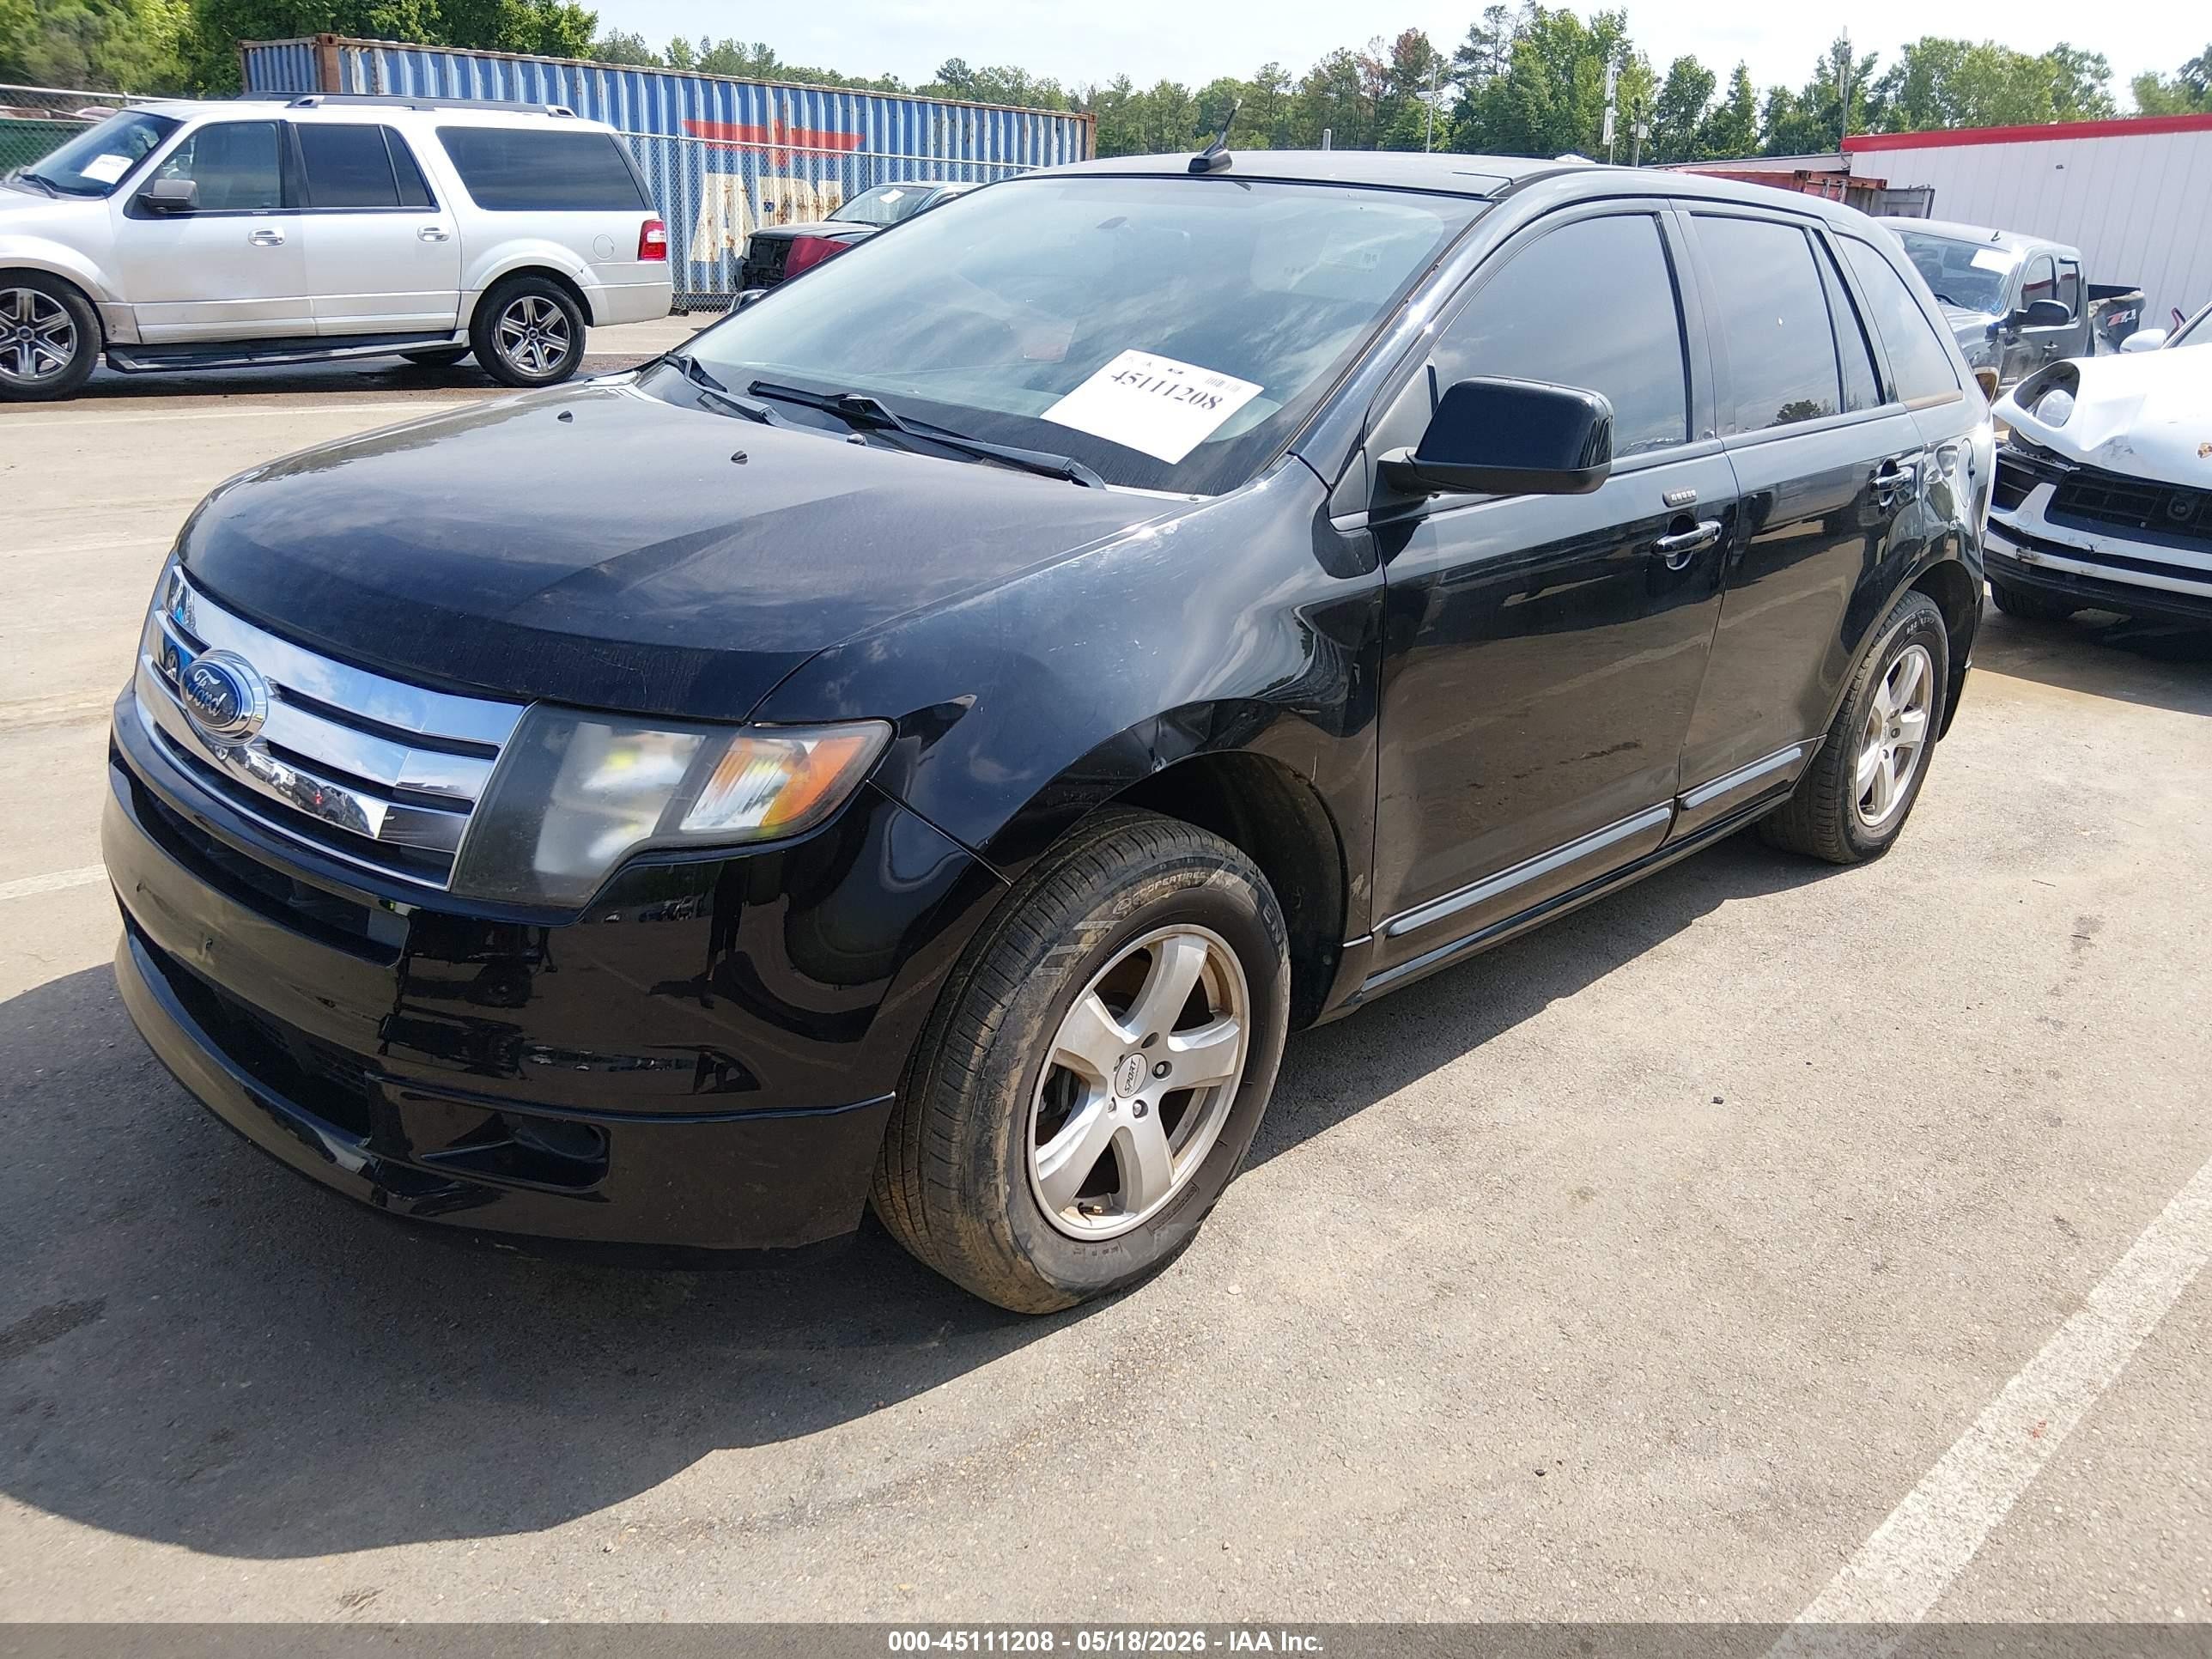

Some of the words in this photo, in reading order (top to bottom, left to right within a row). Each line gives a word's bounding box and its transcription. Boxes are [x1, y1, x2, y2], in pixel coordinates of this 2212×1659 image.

[1110, 370, 1224, 410] 45111208
[185, 668, 228, 717] Ford
[1124, 1057, 1137, 1094] SPORT
